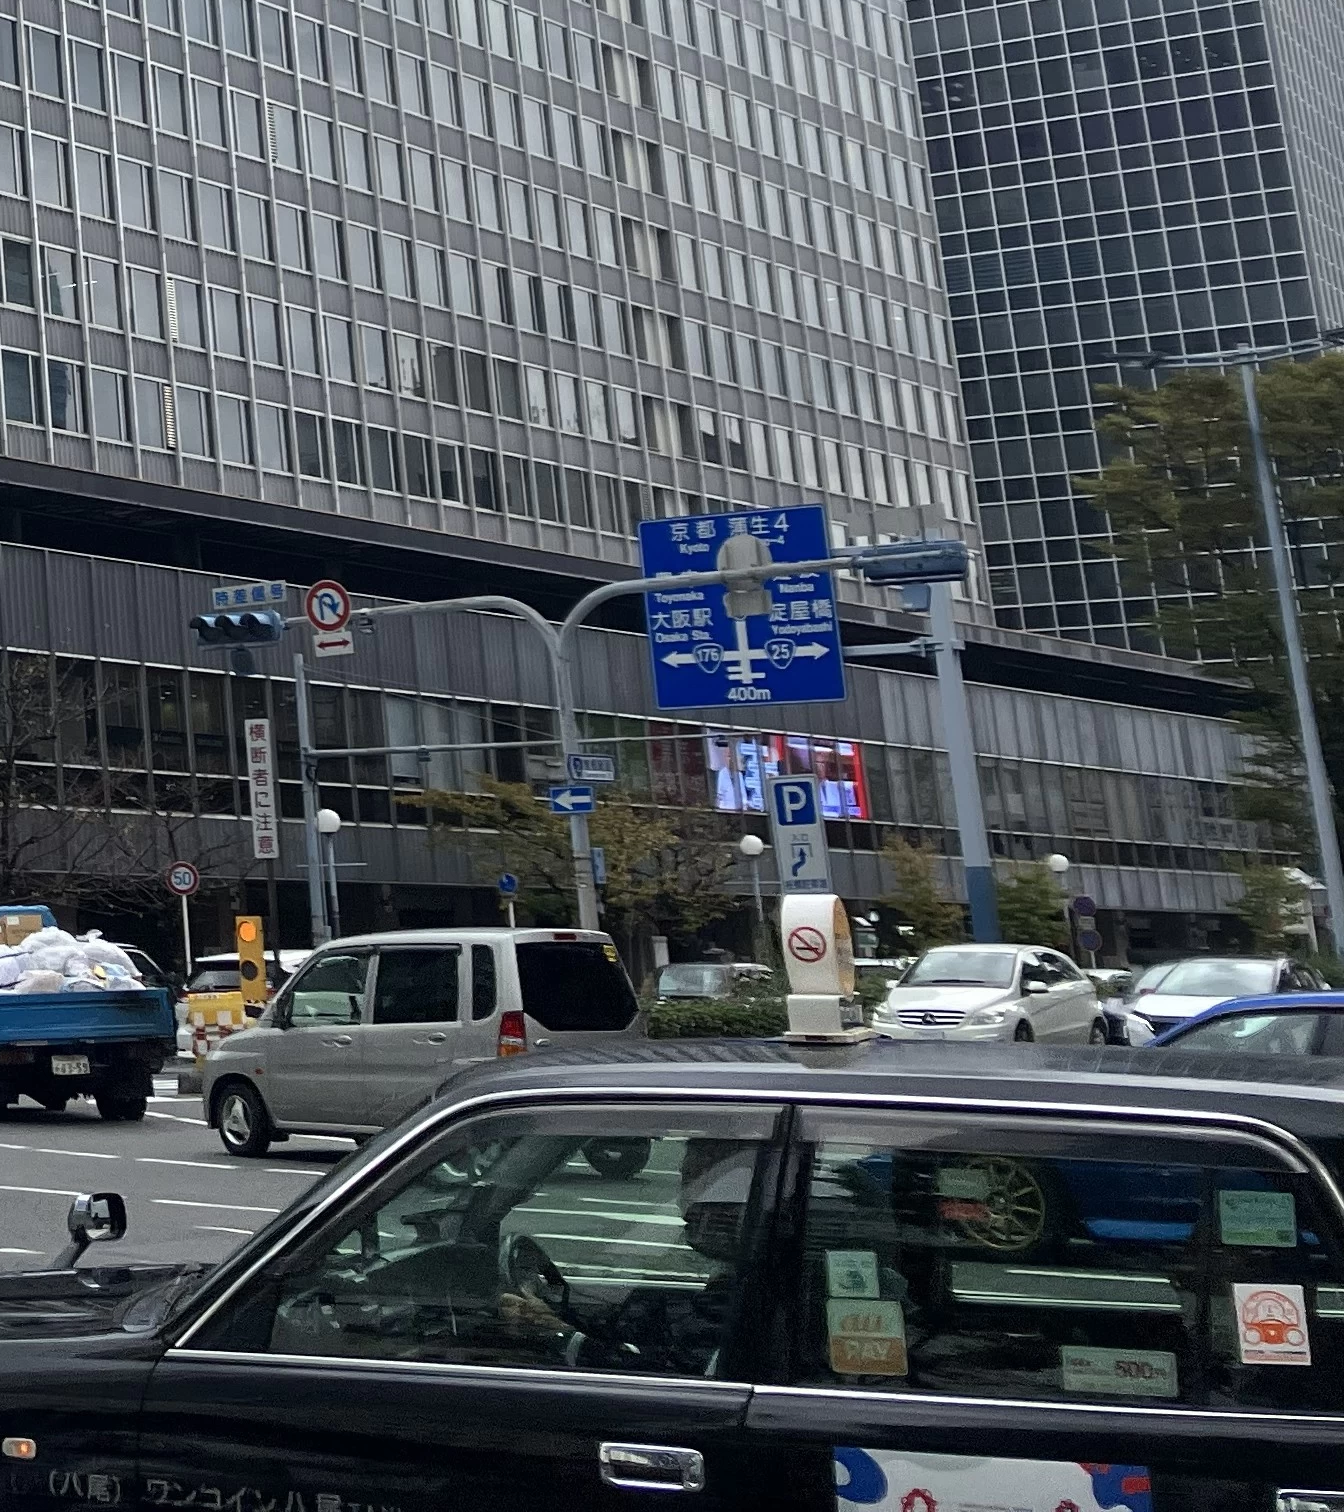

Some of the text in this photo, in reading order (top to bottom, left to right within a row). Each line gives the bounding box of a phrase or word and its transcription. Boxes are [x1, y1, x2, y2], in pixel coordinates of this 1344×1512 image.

[670, 519, 716, 541] 京都
[679, 542, 710, 555] Kyoto
[652, 608, 714, 630] 大阪駅
[697, 648, 718, 662] 176
[772, 644, 790, 659] 25
[728, 687, 771, 701] 400m
[784, 785, 807, 823] P
[173, 871, 191, 886] 50
